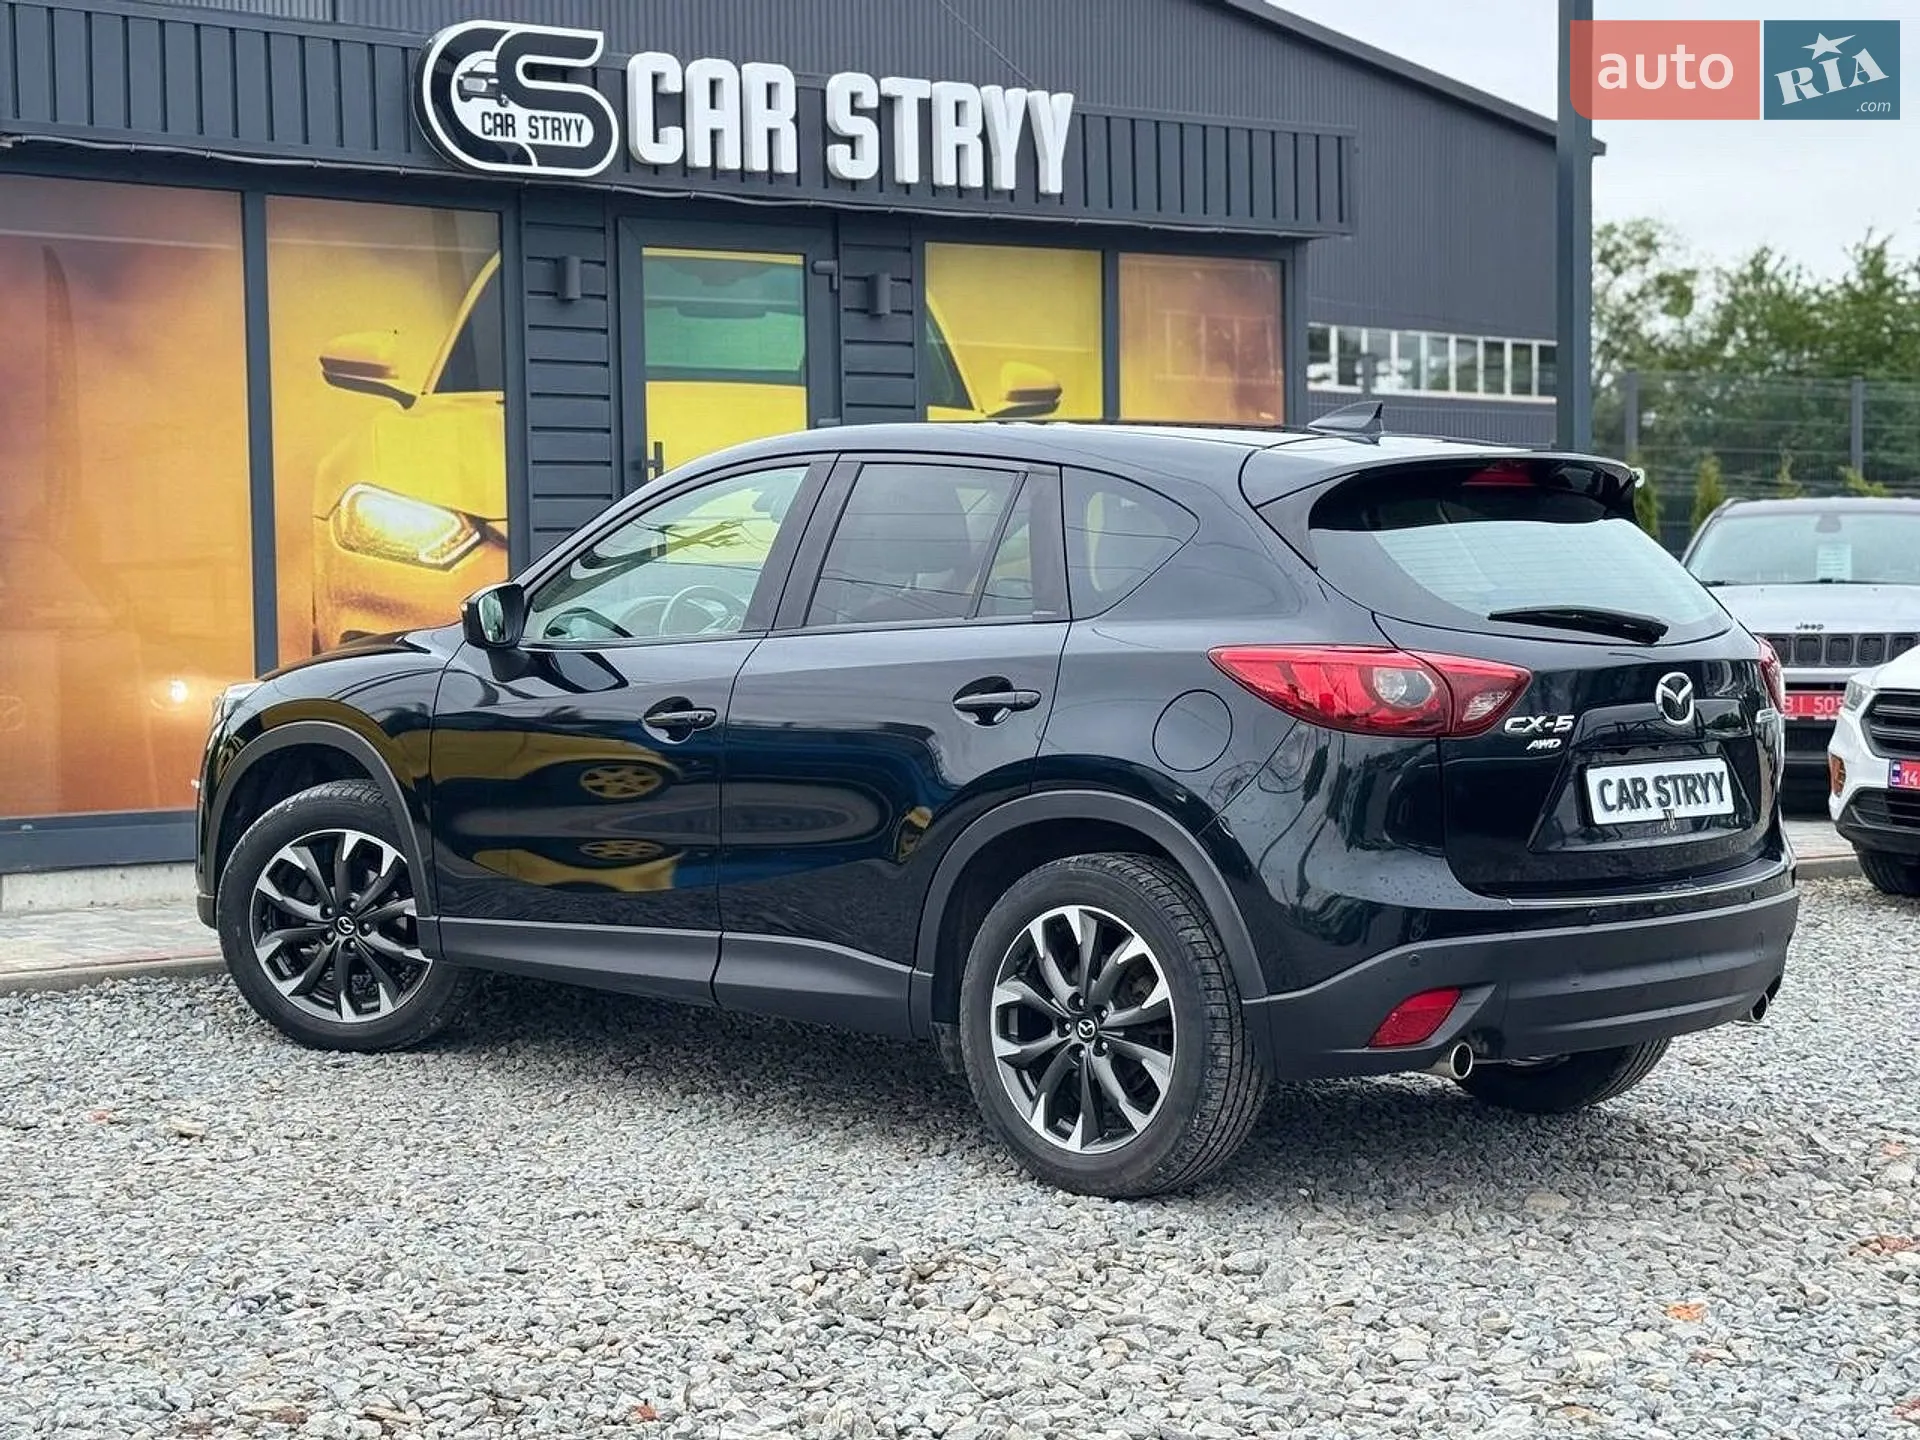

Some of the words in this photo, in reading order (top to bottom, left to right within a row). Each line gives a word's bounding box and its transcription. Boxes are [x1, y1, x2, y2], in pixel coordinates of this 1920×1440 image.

[481, 111, 516, 138] CAR
[528, 115, 584, 143] STRYY
[627, 51, 797, 174] CAR
[826, 71, 1073, 194] STRYY
[1795, 622, 1824, 631] Jeep
[1504, 715, 1575, 733] CX-5
[1526, 738, 1562, 750] AWD
[1598, 778, 1653, 812] CAR
[1653, 771, 1725, 808] STRYY
